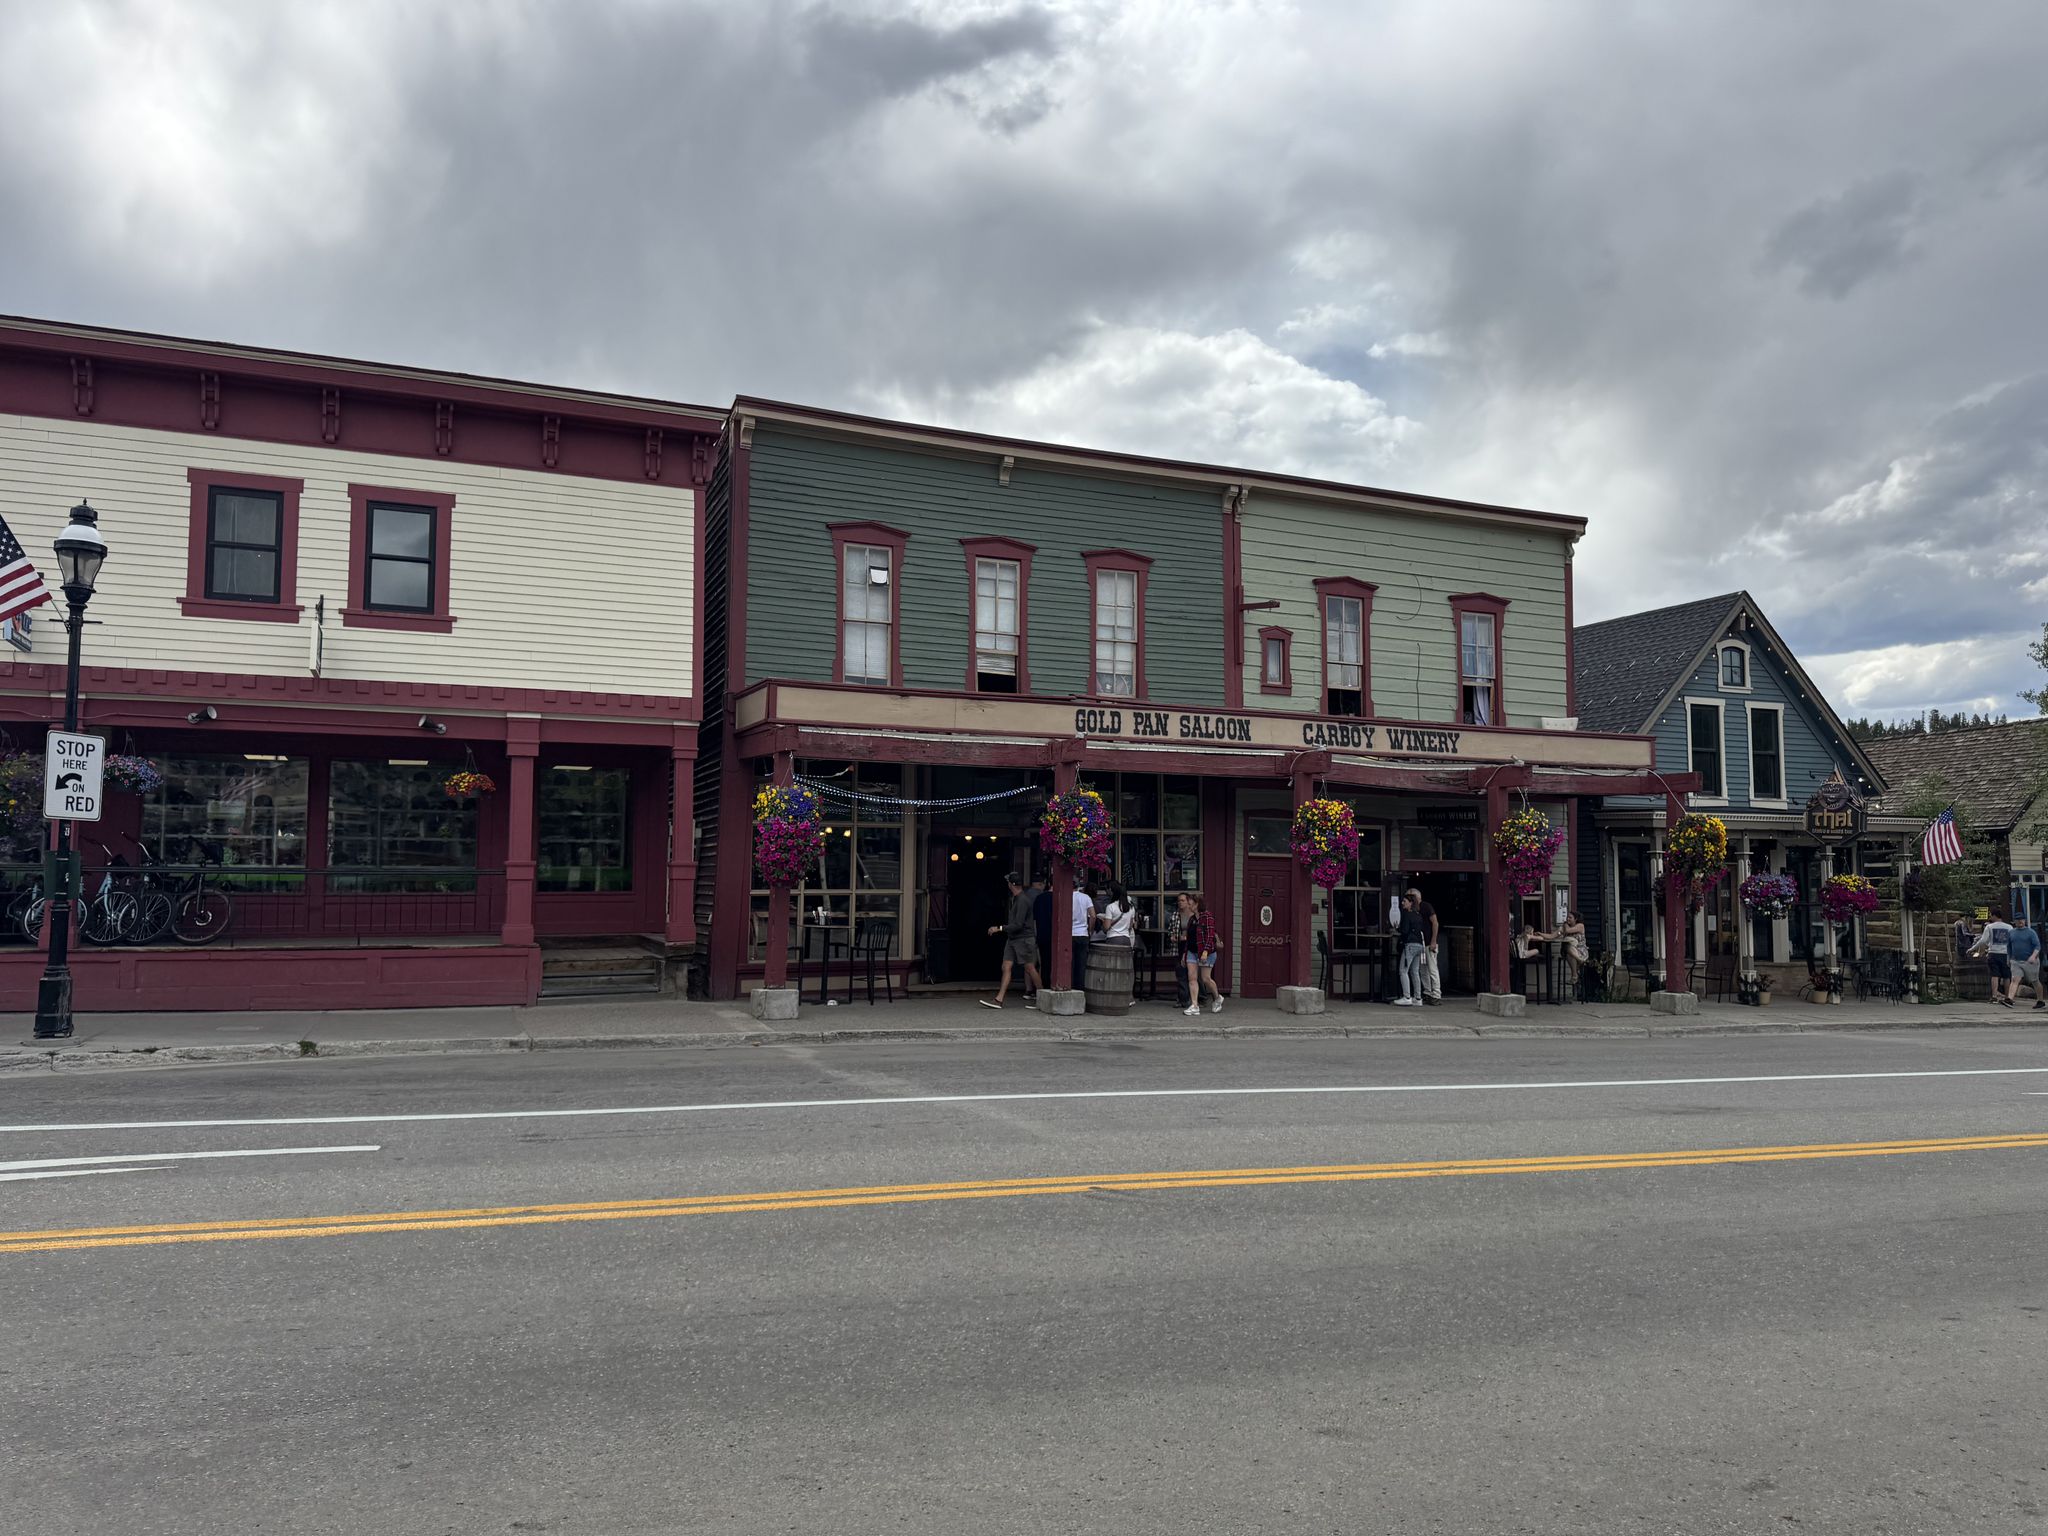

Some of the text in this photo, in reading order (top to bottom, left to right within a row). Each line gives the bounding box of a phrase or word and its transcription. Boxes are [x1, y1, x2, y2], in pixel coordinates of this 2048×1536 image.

[1075, 709, 1251, 741] GOLD PAN SALOON
[1302, 723, 1460, 753] CARBOY WINERY
[56, 739, 96, 758] STOP
[62, 758, 88, 771] HERE
[72, 783, 85, 793] ON
[65, 795, 95, 812] RED
